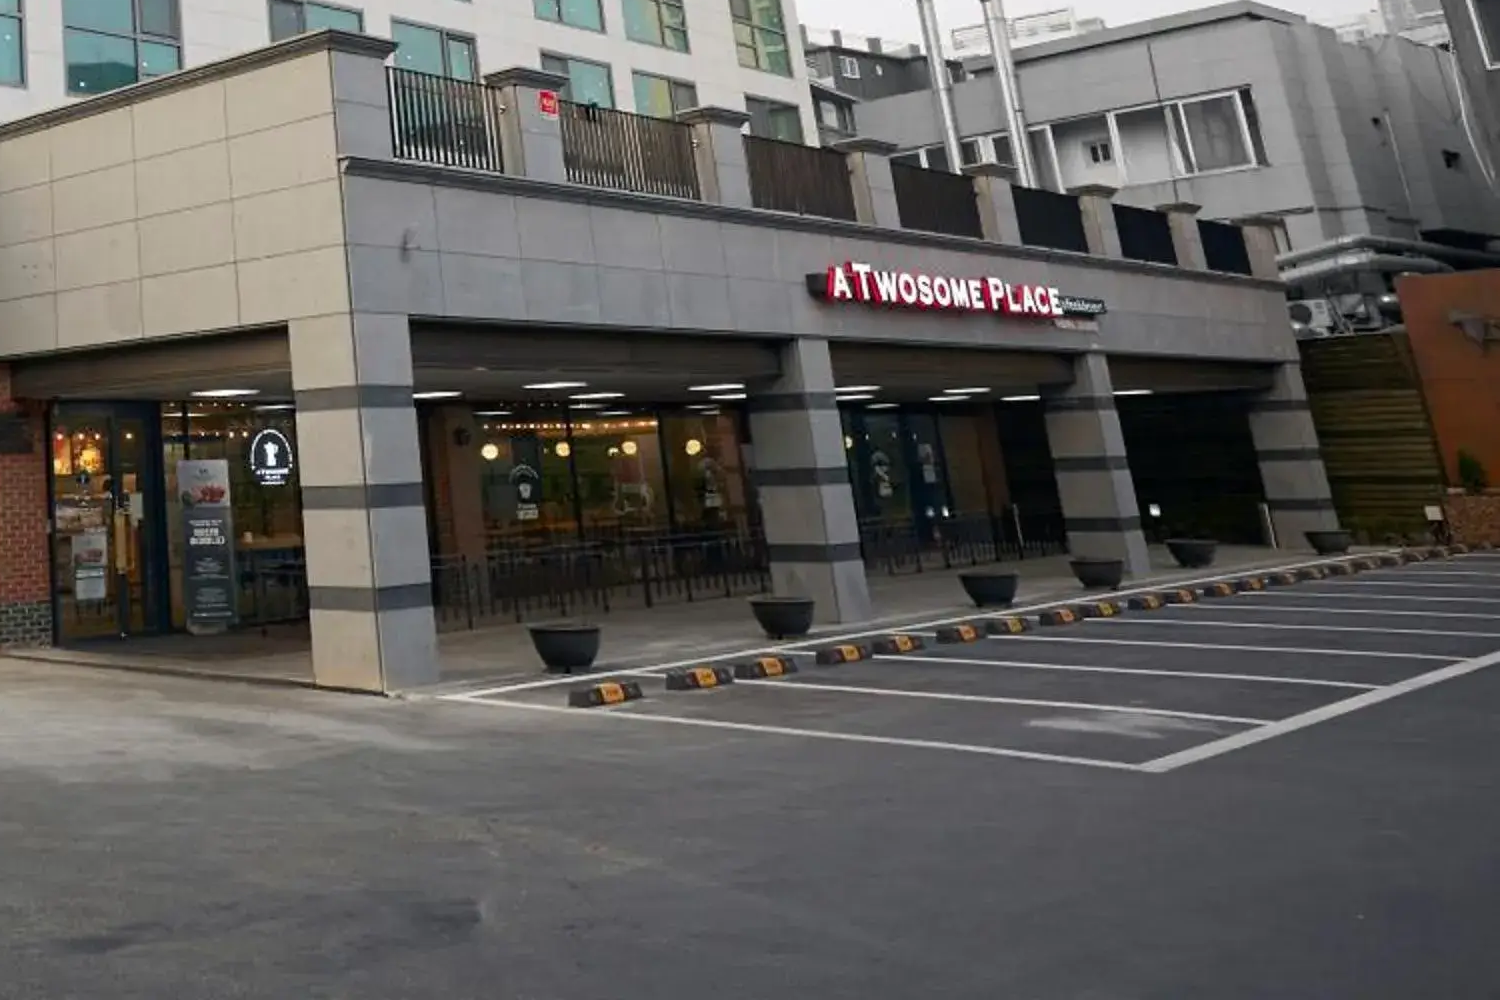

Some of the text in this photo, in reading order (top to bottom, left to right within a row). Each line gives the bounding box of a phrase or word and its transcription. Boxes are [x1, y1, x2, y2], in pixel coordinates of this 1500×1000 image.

[833, 262, 1064, 316] A TWOSOME PLACE
